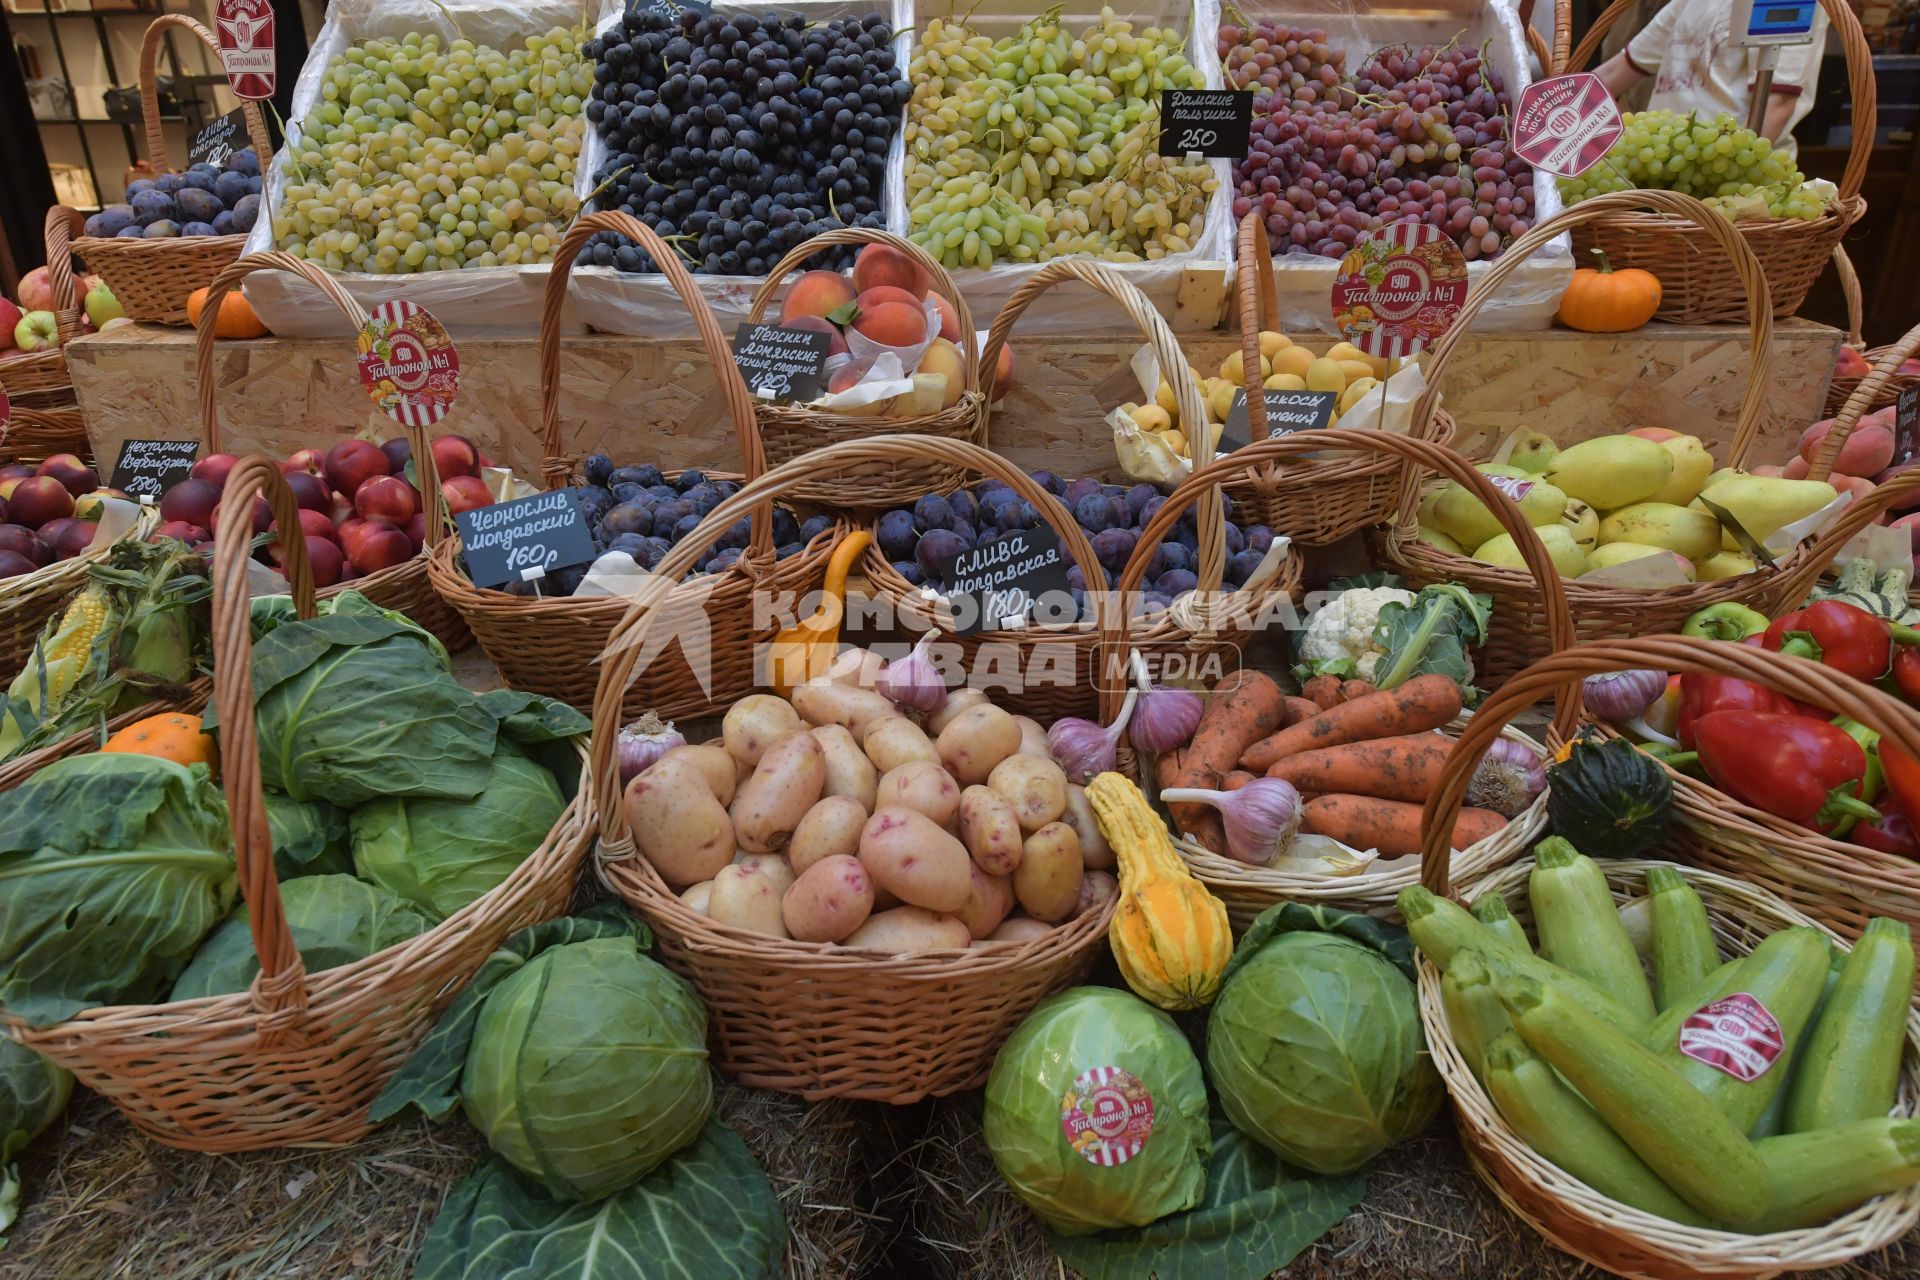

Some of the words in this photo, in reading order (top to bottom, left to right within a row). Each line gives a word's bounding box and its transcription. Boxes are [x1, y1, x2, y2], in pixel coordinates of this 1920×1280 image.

[1171, 91, 1234, 107] Дамские
[1519, 79, 1575, 132] ОФИЦИАЛЬНЫЙ
[1172, 108, 1237, 120] пальчики
[1528, 90, 1573, 134] ПОСТАВЩИК
[1177, 128, 1217, 149] 250
[1549, 118, 1599, 166] Гастроном
[1344, 287, 1433, 305] Гастроном
[1434, 286, 1455, 301] №1
[749, 325, 813, 345] Персики
[367, 361, 434, 381] Гастроном
[432, 352, 450, 369] №1
[126, 441, 198, 454] Нектарины
[1070, 1107, 1133, 1133] Гастроном
